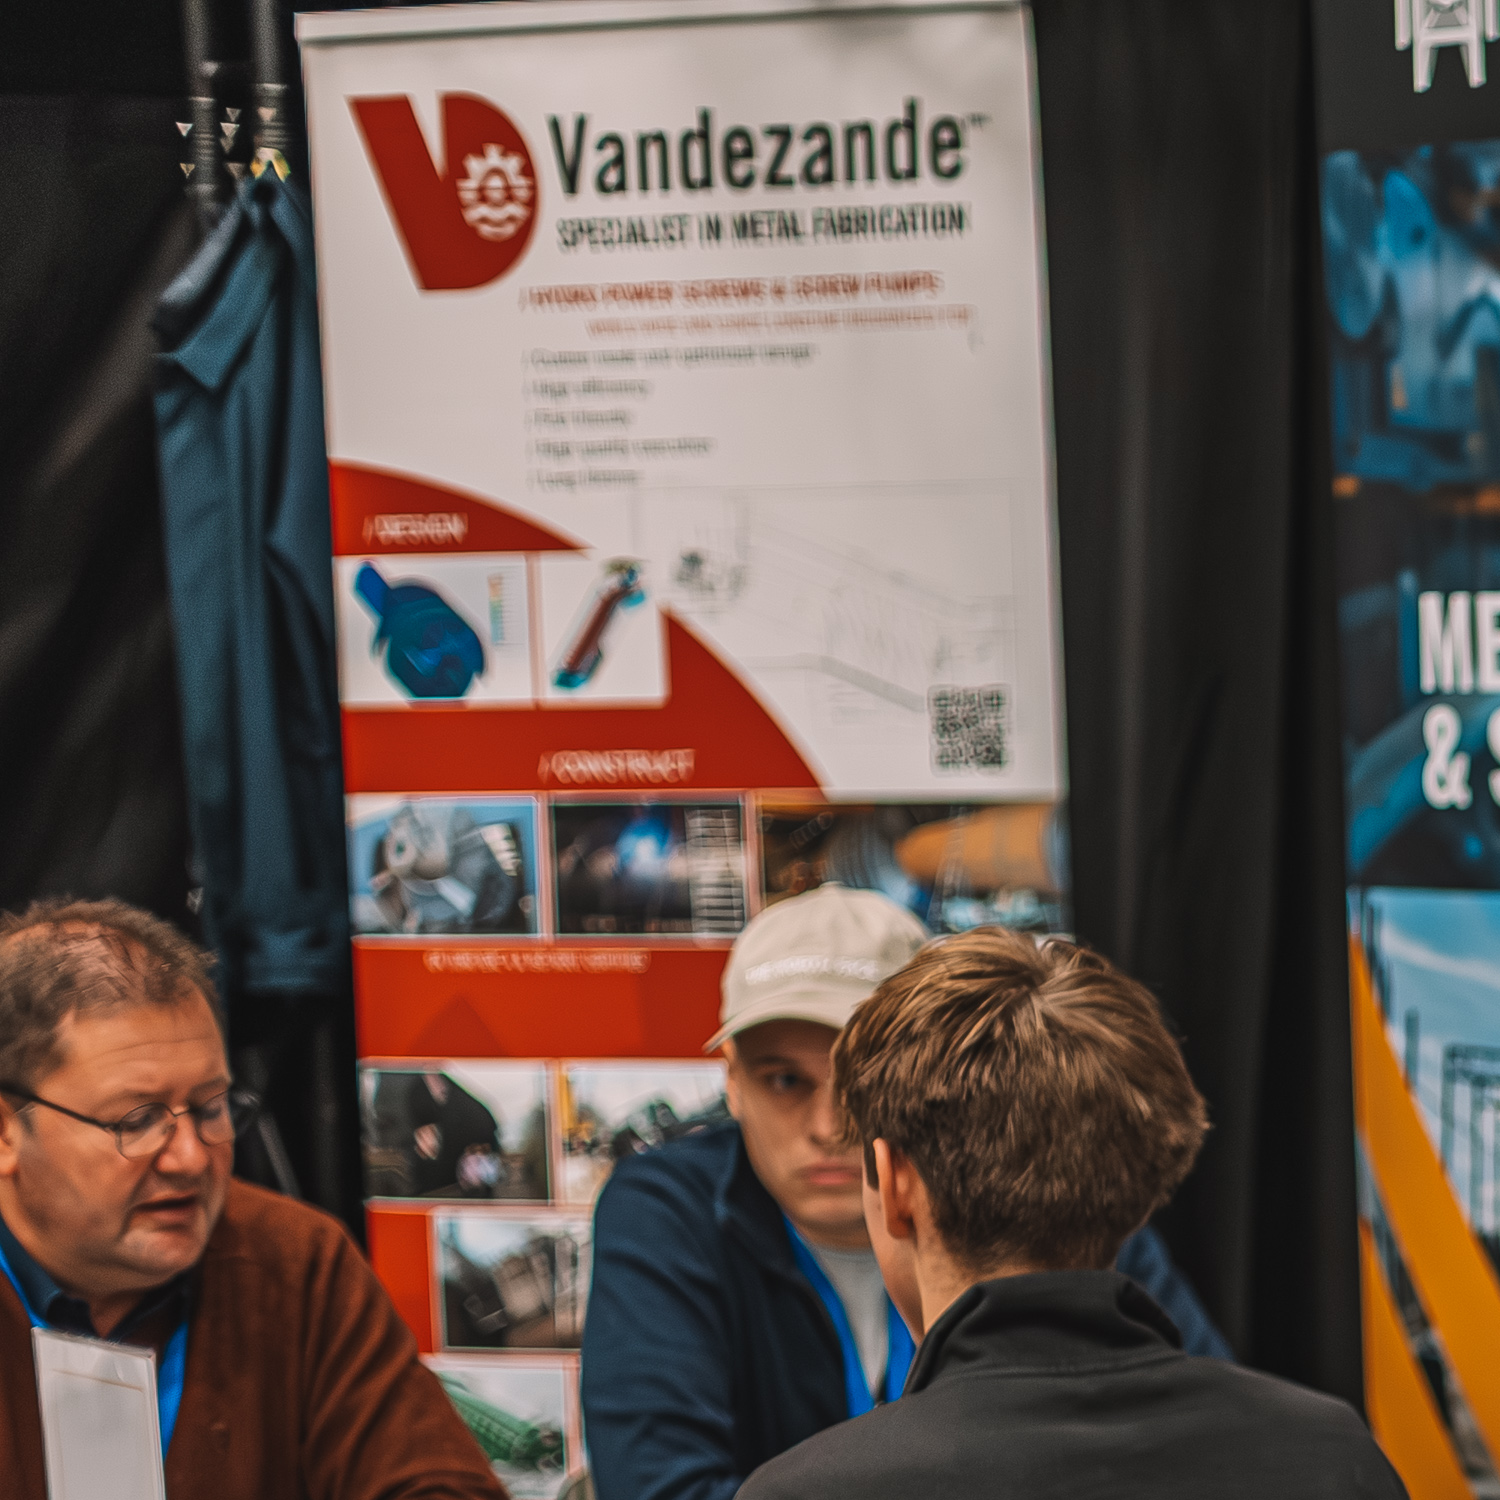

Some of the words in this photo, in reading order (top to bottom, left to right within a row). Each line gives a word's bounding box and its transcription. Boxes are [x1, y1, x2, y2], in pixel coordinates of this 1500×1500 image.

[547, 97, 968, 198] Vandezande
[556, 213, 690, 252] SPECIALIST
[699, 212, 723, 245] IN
[732, 207, 806, 246] METAL
[812, 202, 969, 241] FABRICATION
[1420, 702, 1471, 810] &
